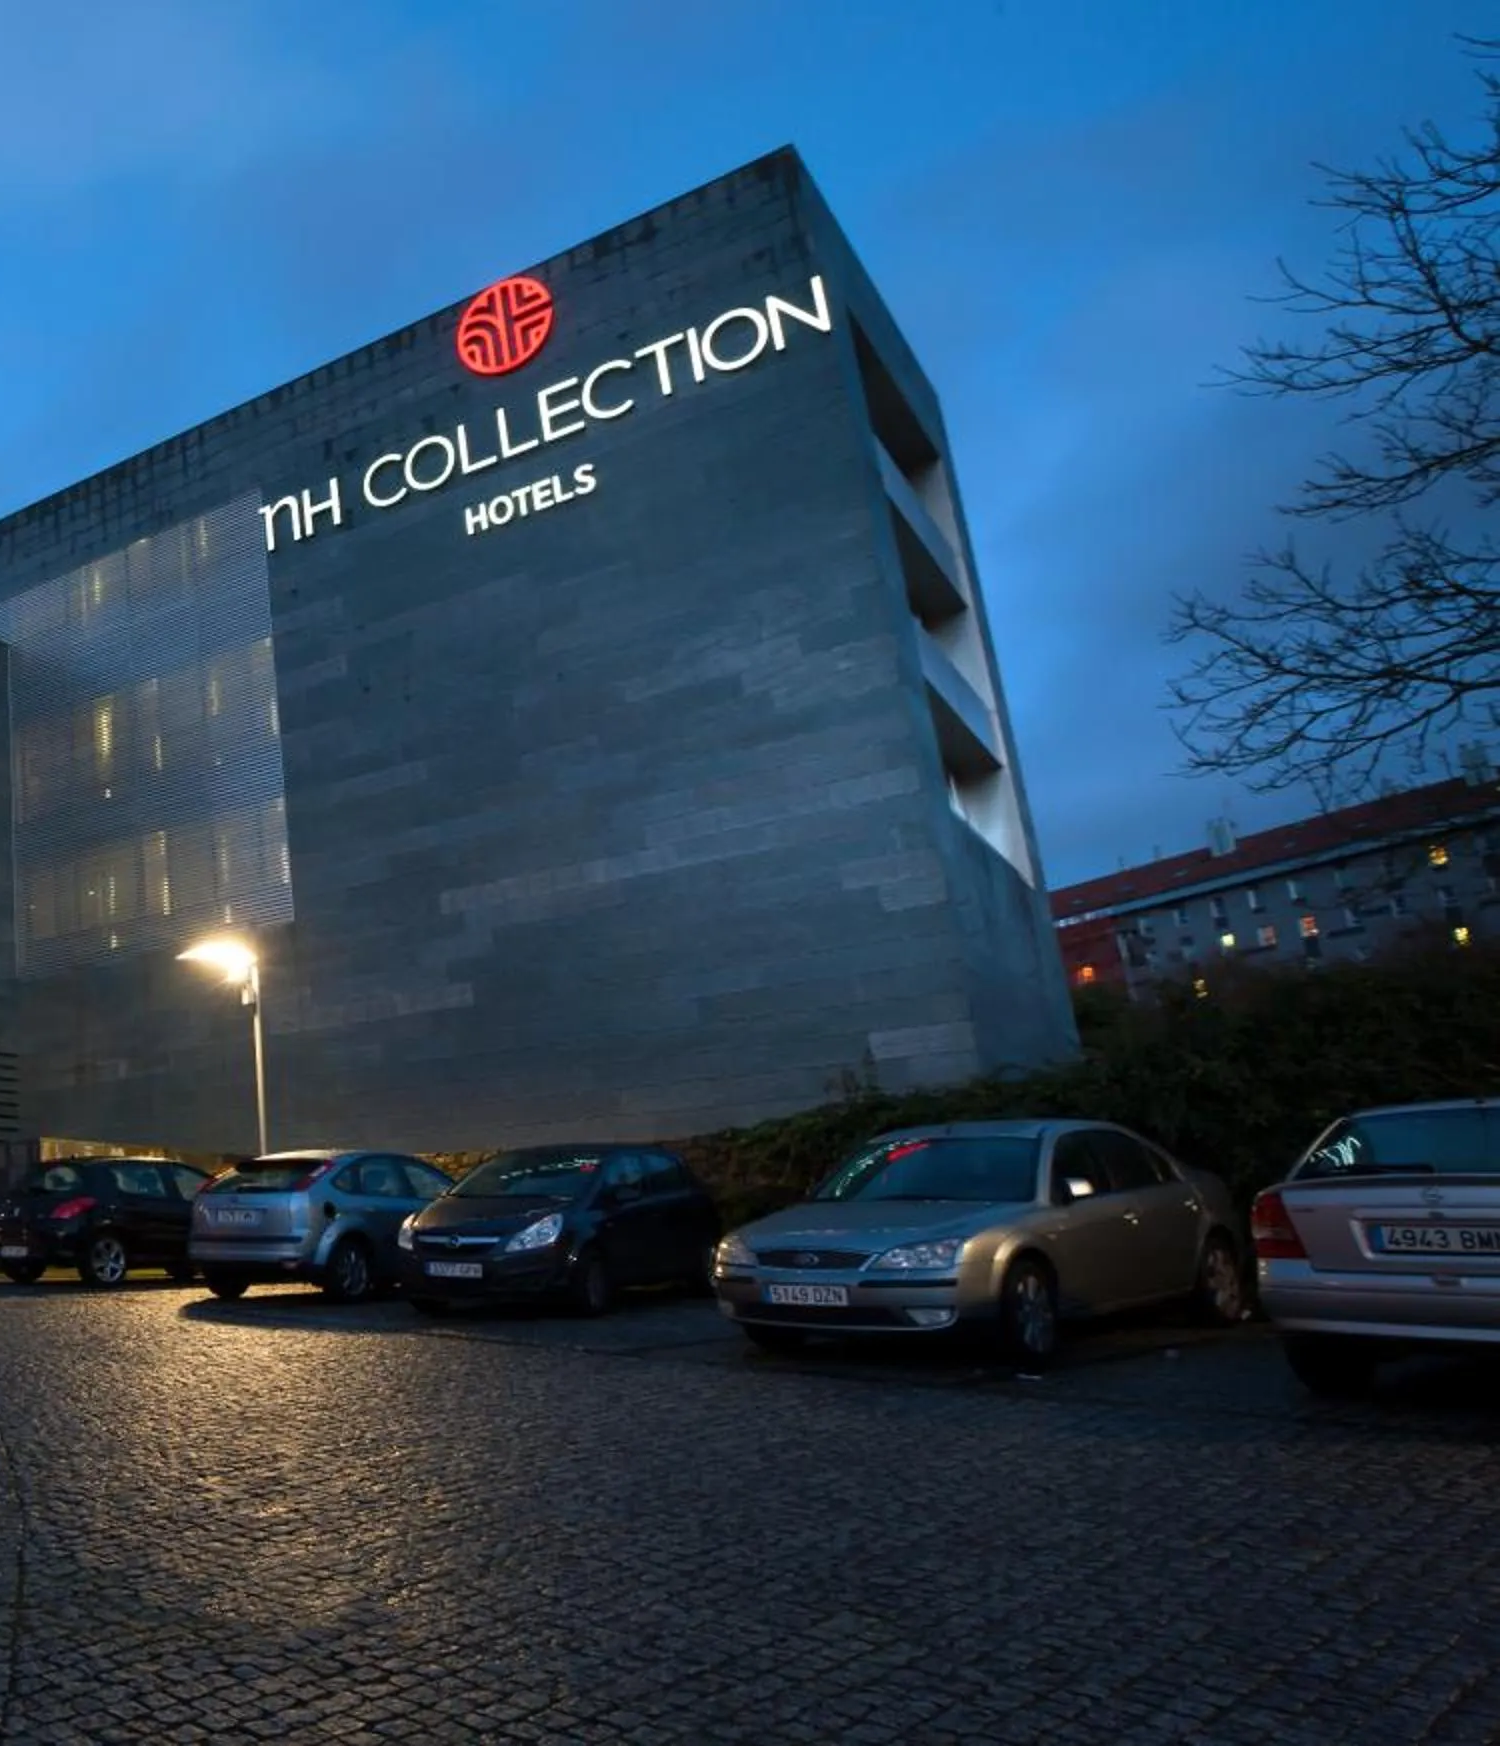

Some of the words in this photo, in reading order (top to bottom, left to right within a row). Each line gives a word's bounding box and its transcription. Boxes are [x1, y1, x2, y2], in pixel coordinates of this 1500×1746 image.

[363, 275, 831, 508] COLLECTION
[464, 463, 597, 535] HOTELS
[1386, 1226, 1451, 1249] 4943
